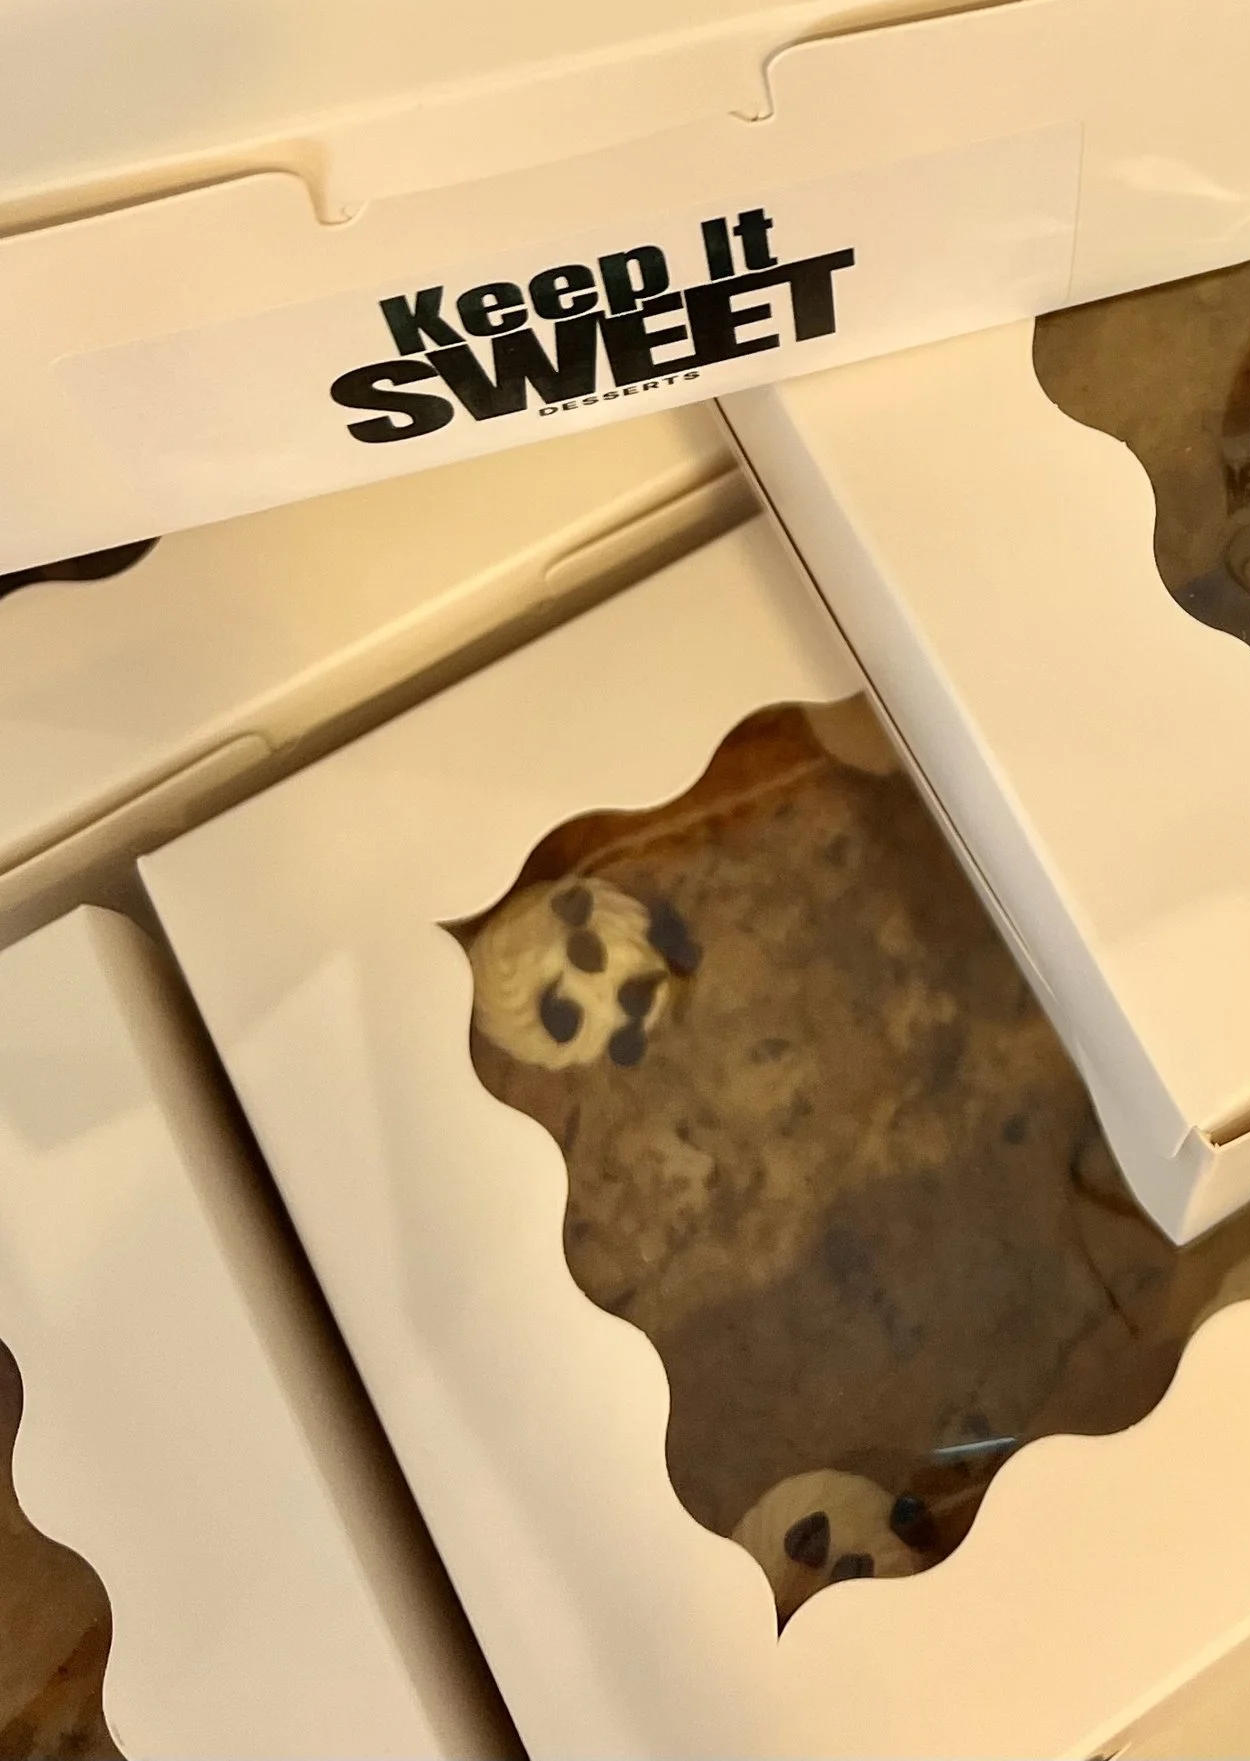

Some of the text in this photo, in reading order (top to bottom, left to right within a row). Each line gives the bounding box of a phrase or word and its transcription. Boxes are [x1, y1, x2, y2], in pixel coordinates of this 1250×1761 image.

[330, 247, 855, 444] SWEET
[379, 208, 778, 357] Keep It
[538, 370, 701, 417] DESSERTS
